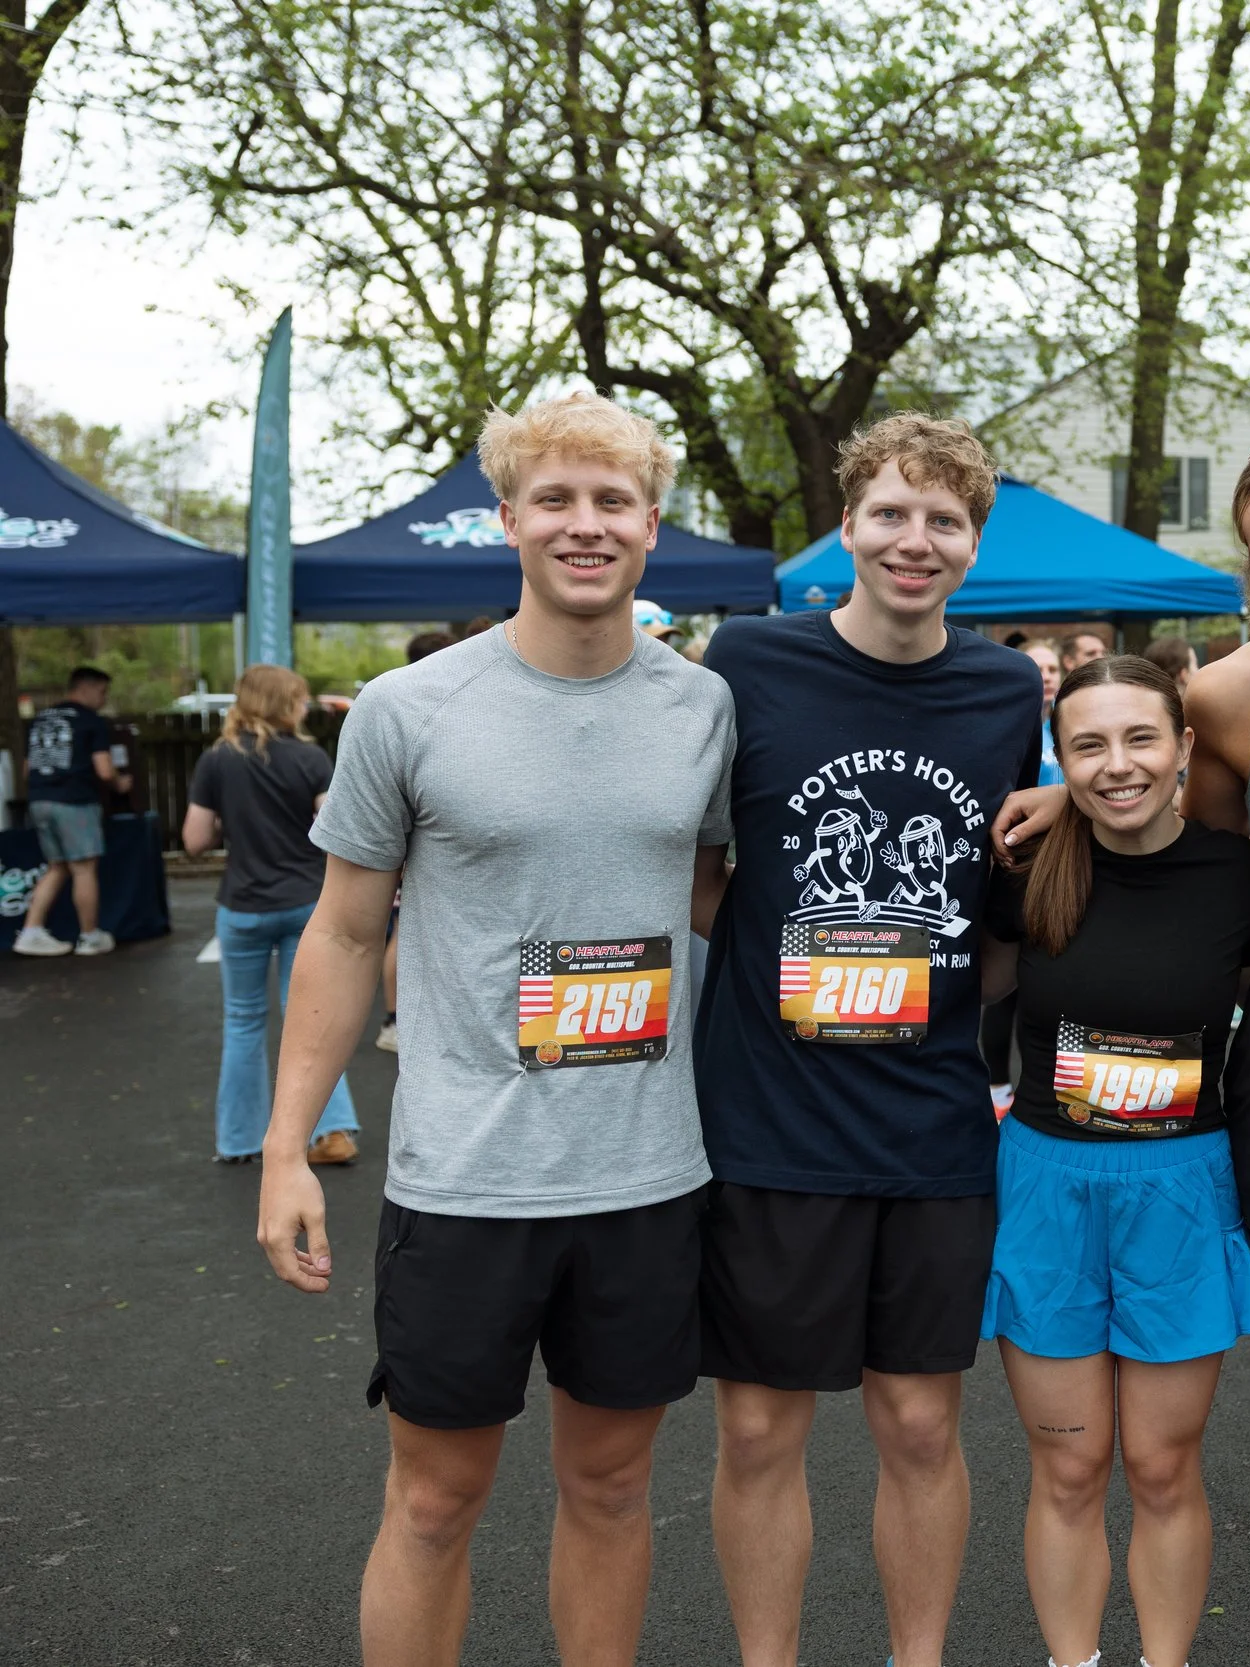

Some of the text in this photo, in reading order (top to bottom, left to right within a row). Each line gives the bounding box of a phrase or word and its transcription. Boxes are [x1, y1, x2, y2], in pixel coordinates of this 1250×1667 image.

[787, 749, 985, 832] POTTER'S HOUSE
[782, 835, 800, 850] 20
[972, 847, 982, 862] 2
[832, 930, 901, 942] HEARTLAND
[576, 943, 645, 957] HEARTLAND
[929, 952, 971, 969] UN RUN
[812, 966, 909, 1015] 2160
[555, 980, 653, 1036] 2158
[1105, 1034, 1174, 1049] HEARTLAND
[1087, 1063, 1180, 1112] 1998
